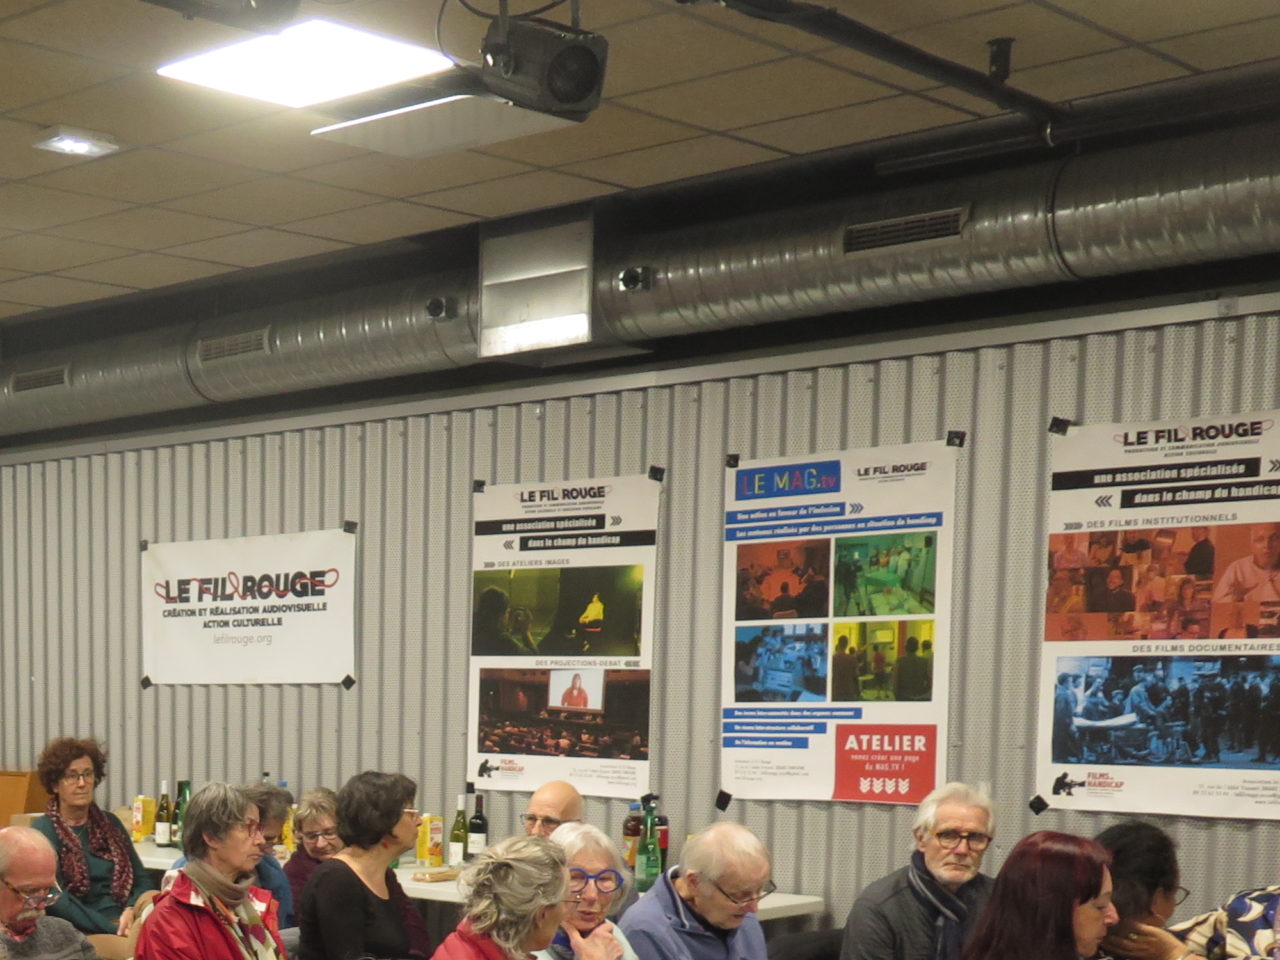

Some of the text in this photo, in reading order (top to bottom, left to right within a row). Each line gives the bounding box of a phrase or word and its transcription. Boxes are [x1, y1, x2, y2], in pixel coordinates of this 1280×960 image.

[1123, 421, 1263, 446] LE FIL ROUGE
[857, 467, 871, 477] LE
[873, 465, 888, 475] FIL
[892, 462, 928, 474] ROUGE
[1094, 463, 1246, 484] une association spécialisée
[742, 473, 766, 495] LE
[521, 486, 605, 502] LE FIL ROUGE
[1134, 491, 1161, 504] dans
[1162, 490, 1173, 502] le
[1174, 488, 1212, 502] champ
[1213, 487, 1229, 498] du
[502, 518, 597, 532] une association spécialisée
[1086, 513, 1238, 529] DES FILMS INSTITUTIONNELS
[527, 538, 544, 548] dans
[545, 538, 553, 547] le
[554, 537, 577, 548] champ
[588, 535, 620, 545] handicap
[512, 559, 543, 567] ATELIERS
[545, 558, 570, 566] IMAGES
[165, 570, 326, 603] LE FIL ROUGE
[163, 602, 327, 618] CRÉATION ET RÉALISATION AUDIOVISUELLE
[203, 617, 283, 629] ACTION CULTURELLE
[1132, 645, 1152, 653] DES
[1155, 644, 1185, 652] FILMS
[844, 734, 927, 751] ATELIER
[903, 755, 920, 763] page
